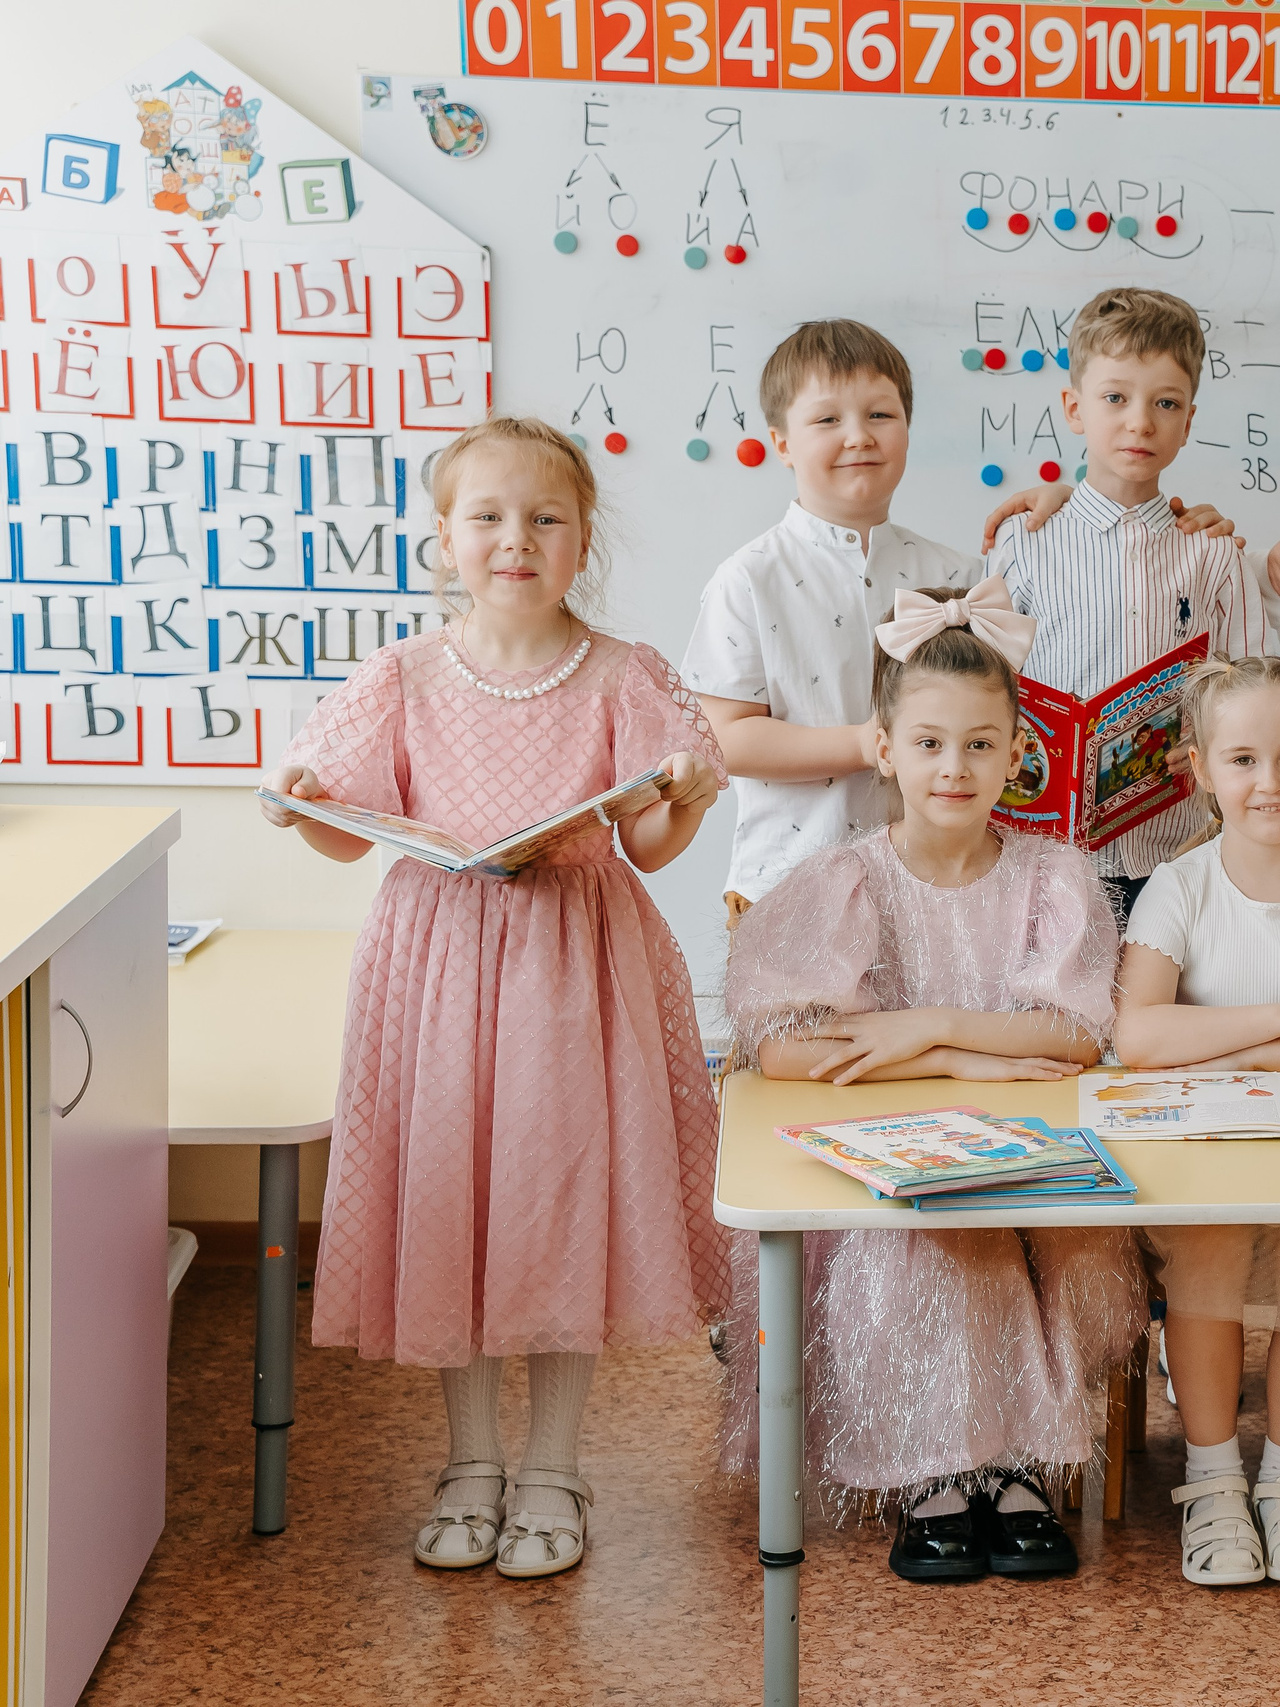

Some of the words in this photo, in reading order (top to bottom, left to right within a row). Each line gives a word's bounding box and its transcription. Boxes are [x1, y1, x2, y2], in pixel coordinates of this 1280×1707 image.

[473, 0, 523, 66] 0
[545, 0, 578, 69] 1
[601, 0, 649, 73] 2
[664, 1, 711, 74] 3
[723, 6, 775, 78] 4
[788, 7, 834, 79] 5
[846, 10, 897, 82] 6
[909, 13, 955, 84] 7
[968, 14, 1017, 86] 8
[1029, 17, 1078, 88] 9
[1085, 19, 1142, 91] 10
[1147, 23, 1199, 93] 11
[1205, 24, 1261, 95] 12
[583, 92, 610, 147] Ё
[704, 106, 744, 150] Я
[62, 155, 90, 189] Б
[303, 180, 329, 214] Е
[959, 171, 1185, 219] ФОНАРИ
[57, 256, 96, 297] О
[283, 258, 368, 321] Ы
[414, 264, 465, 323] Э
[576, 327, 628, 375] Ю
[709, 324, 737, 374] Е
[975, 292, 1077, 351] ЁЛК
[48, 326, 101, 400] Ё
[161, 341, 247, 402] Ю
[307, 361, 370, 420] И
[411, 351, 466, 409] Е
[980, 402, 1089, 461] МА
[35, 430, 93, 488] В
[139, 439, 186, 494] Р
[224, 437, 287, 497] Н
[314, 433, 397, 508] П
[40, 513, 91, 568] Т
[130, 502, 190, 574] Д
[238, 513, 277, 571] З
[319, 520, 392, 577] М
[32, 594, 99, 666] Ц
[135, 597, 199, 654] К
[225, 610, 301, 667] Ж
[63, 682, 126, 739] Ъ
[190, 684, 243, 741] Ь
